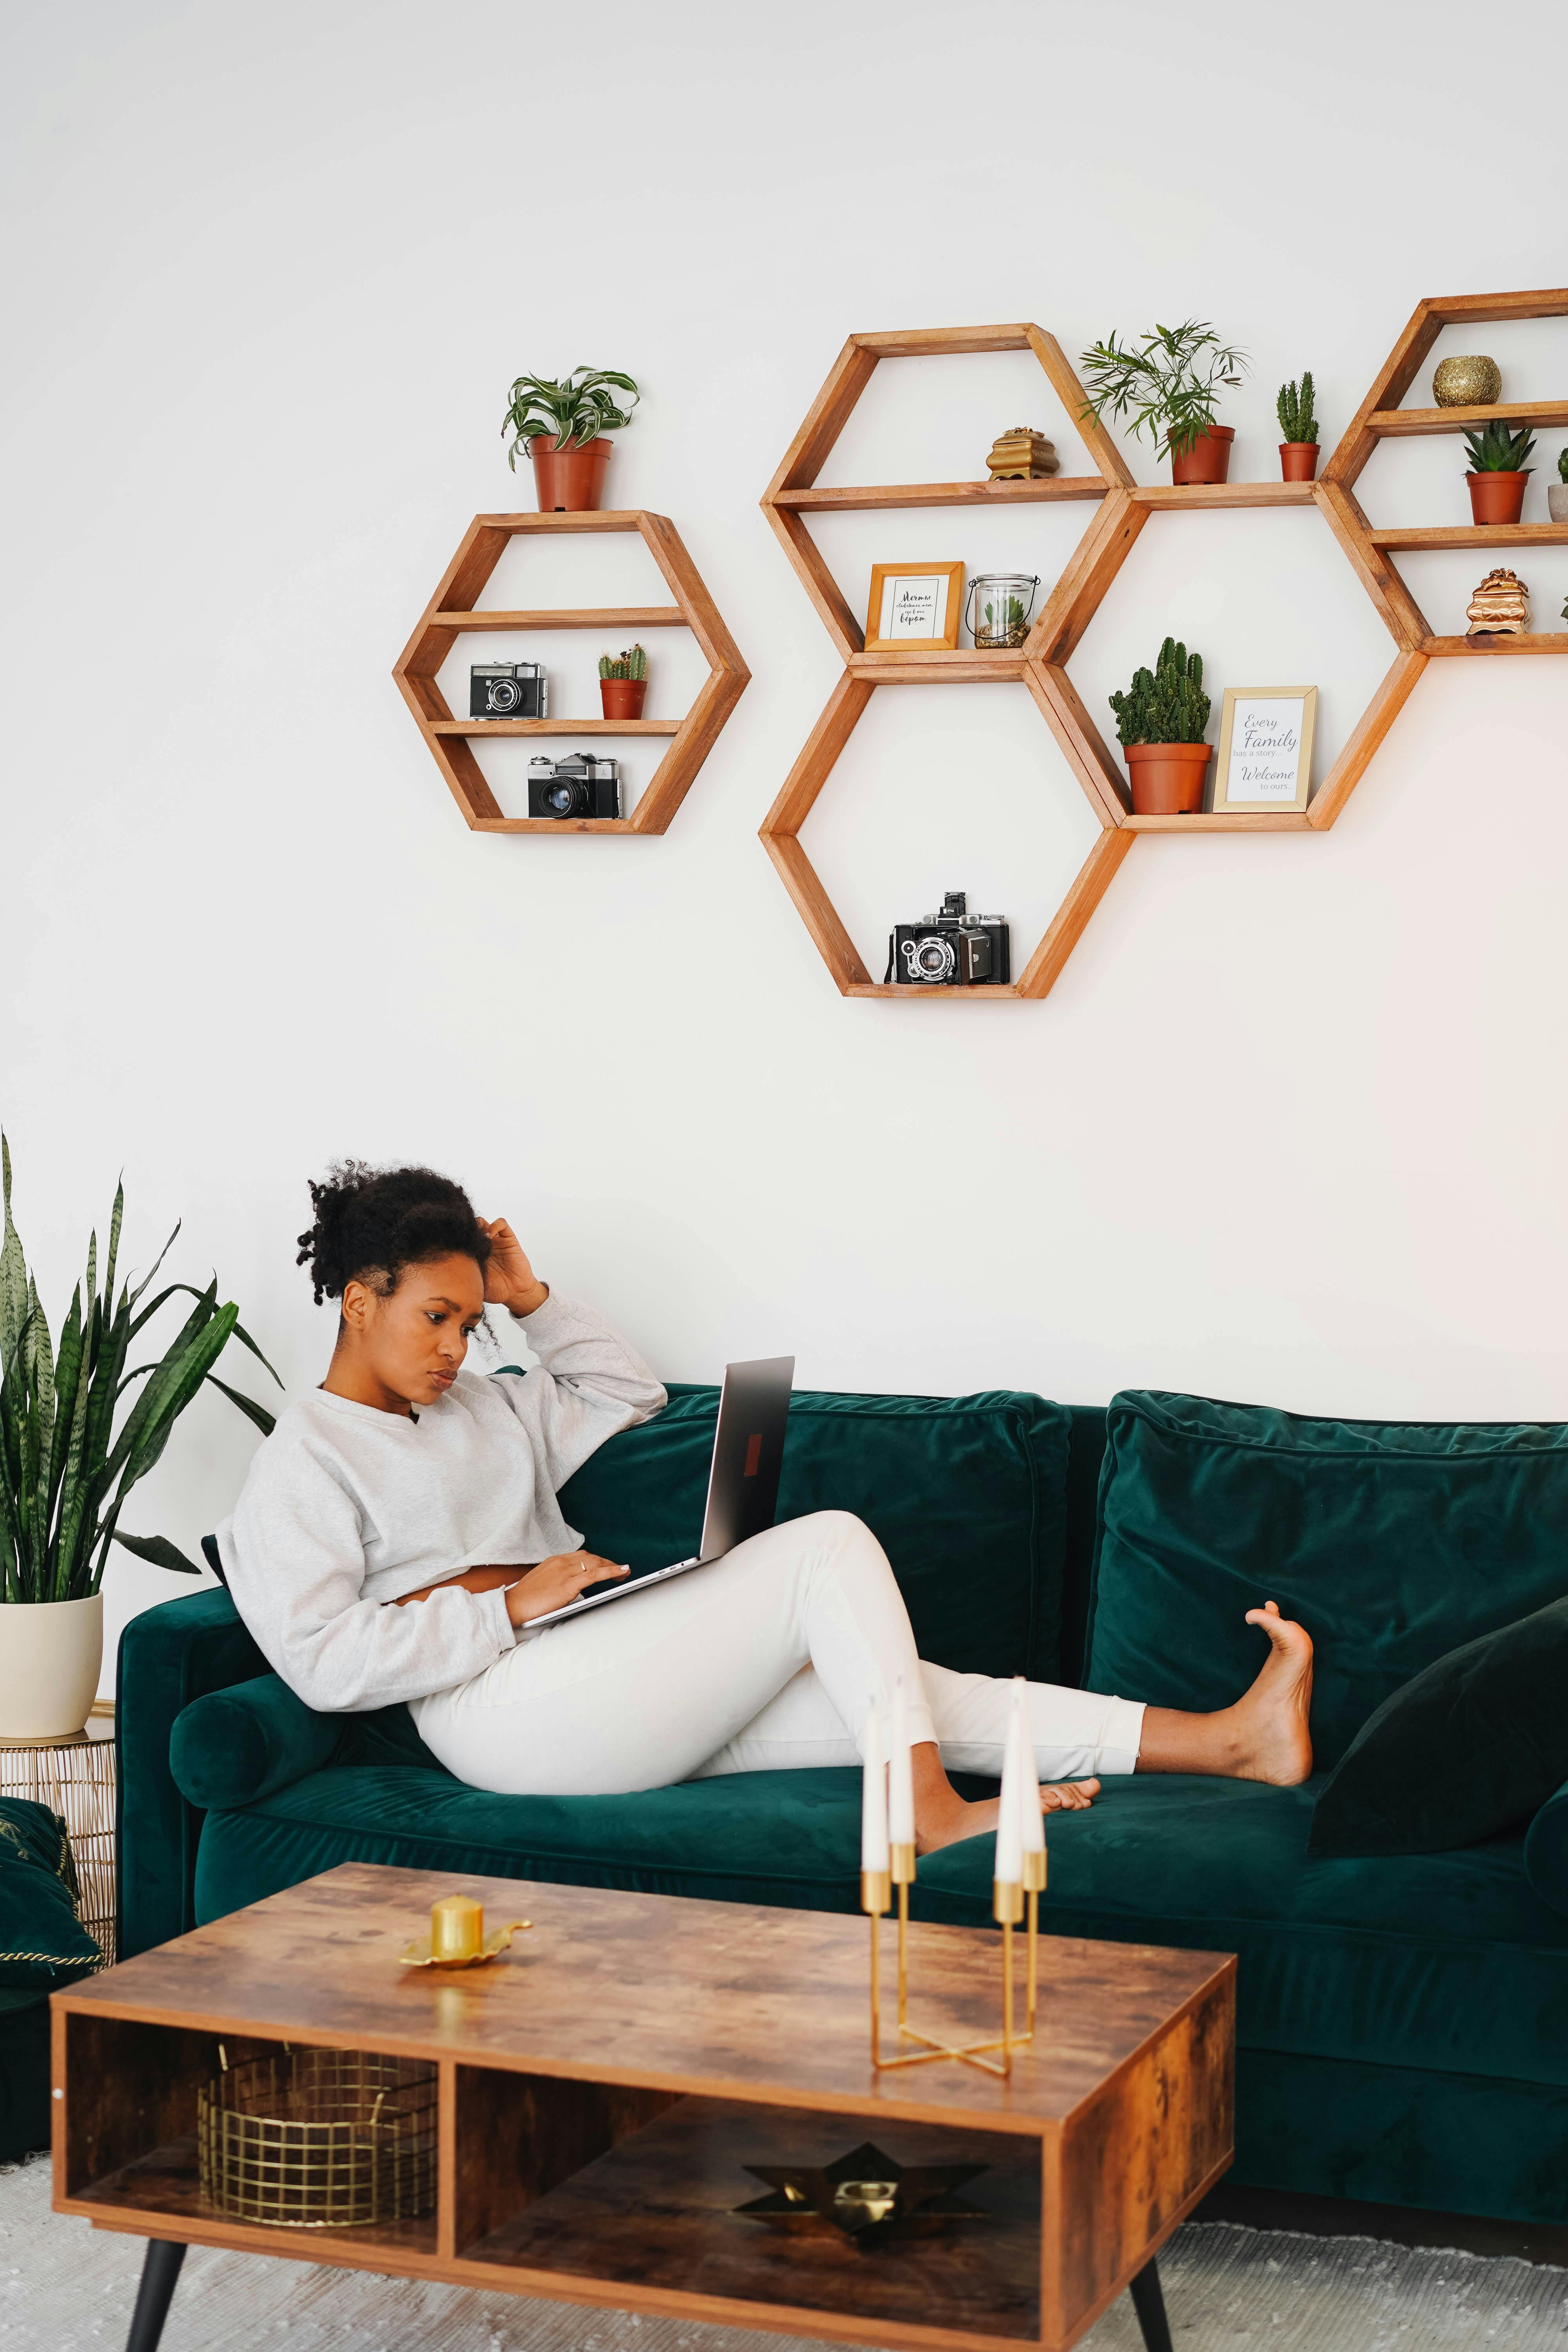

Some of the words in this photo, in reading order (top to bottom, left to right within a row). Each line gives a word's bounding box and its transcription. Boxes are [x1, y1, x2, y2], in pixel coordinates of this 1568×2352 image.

[901, 591, 931, 602] Мечты
[900, 613, 926, 625] верят
[1244, 714, 1278, 730] Every
[1245, 729, 1298, 752] Family
[1241, 766, 1294, 780] Welcome
